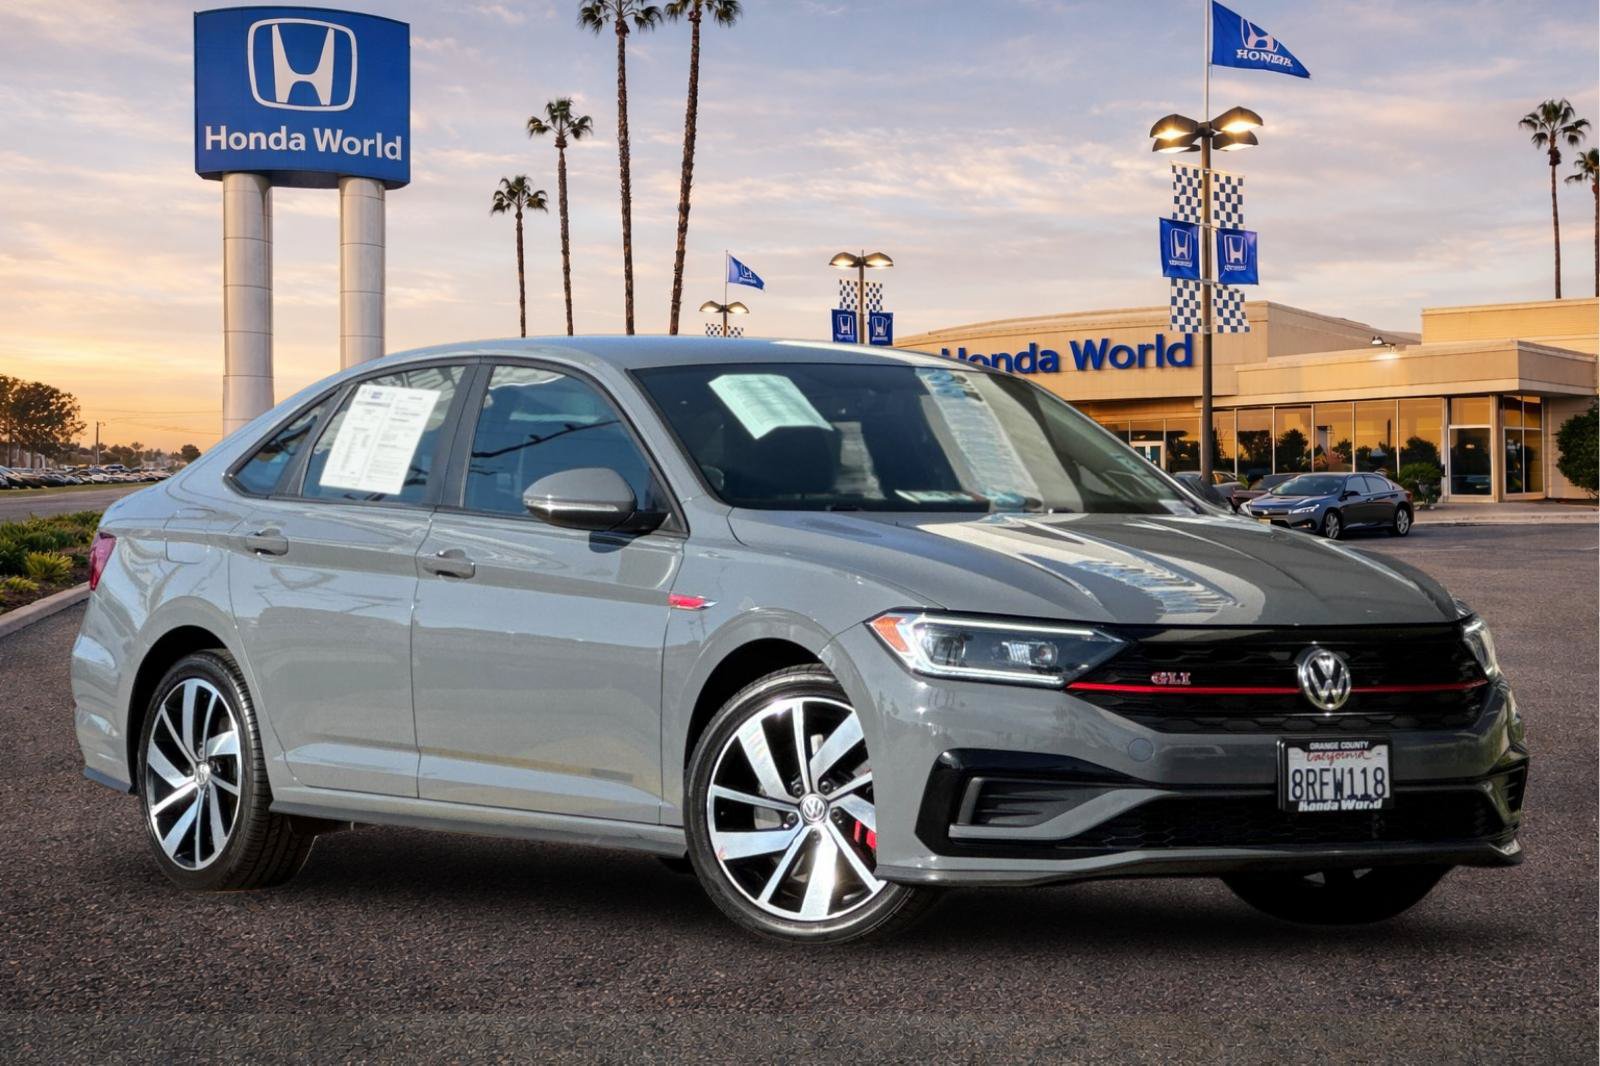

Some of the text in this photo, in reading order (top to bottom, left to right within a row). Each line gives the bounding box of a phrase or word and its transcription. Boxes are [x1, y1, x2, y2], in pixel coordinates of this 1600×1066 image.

[205, 125, 402, 161] Honda World
[1069, 333, 1194, 371] World
[1151, 672, 1191, 685] GLI
[1340, 741, 1369, 749] COUNTY
[1292, 767, 1386, 801] 8RFW118
